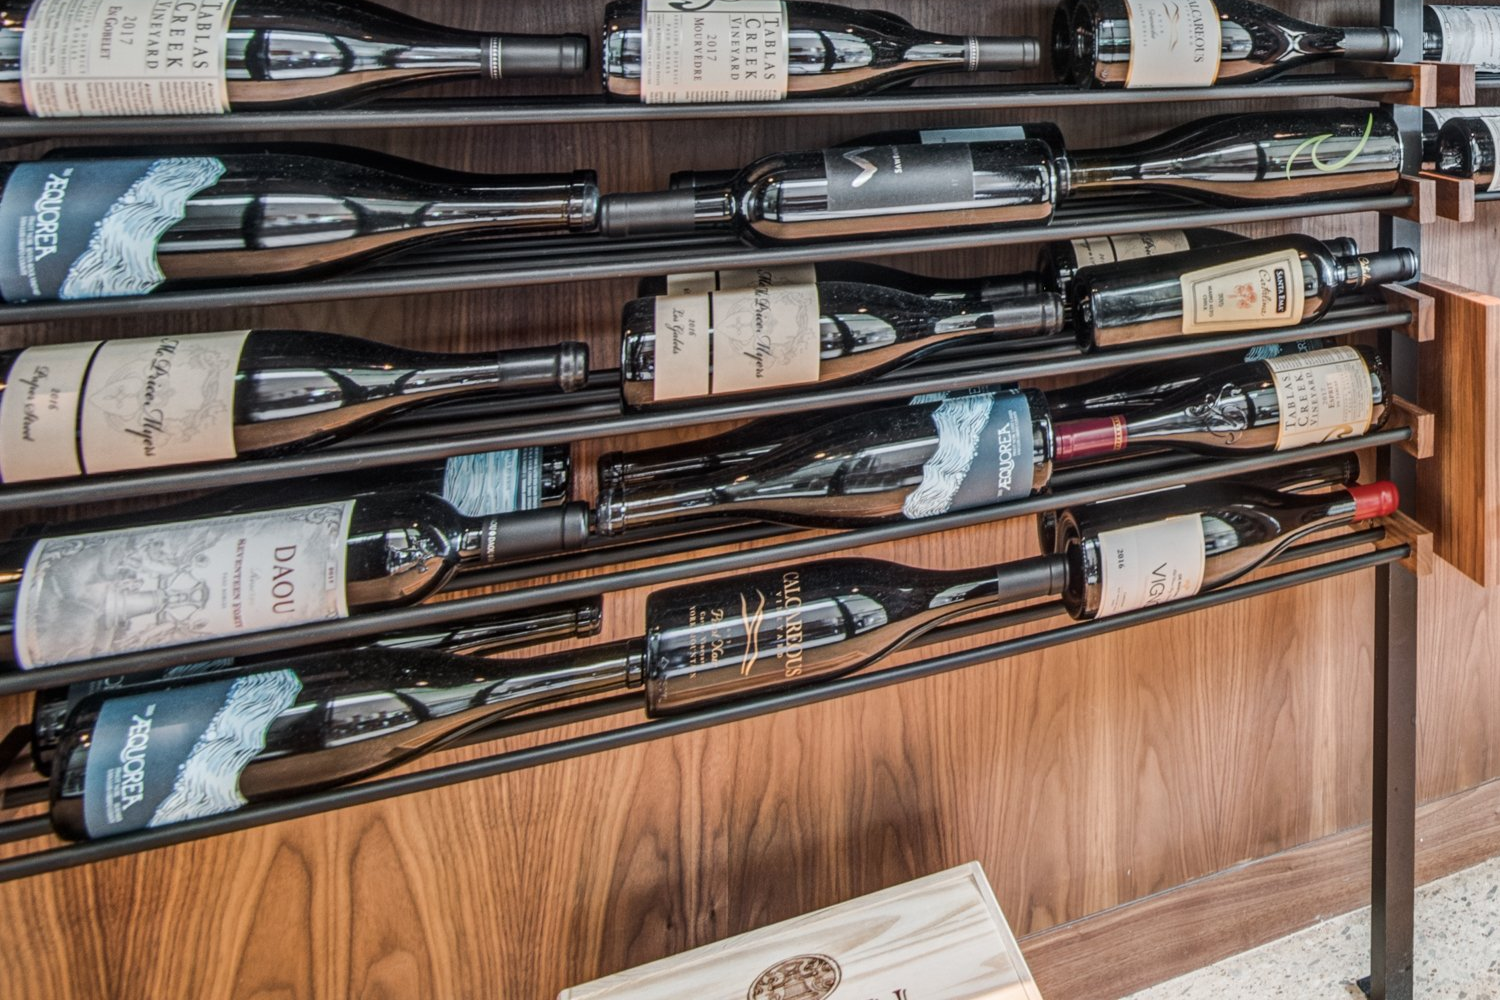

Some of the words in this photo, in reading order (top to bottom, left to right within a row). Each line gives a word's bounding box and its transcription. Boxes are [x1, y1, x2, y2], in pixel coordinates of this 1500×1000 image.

[101, 17, 119, 60] GOBELET
[119, 15, 138, 46] 2017
[146, 0, 173, 70] VINEYARD
[166, 1, 197, 69] CREEK
[192, 0, 224, 70] TABLAS
[706, 34, 717, 62] 2017
[731, 17, 743, 81] VINEYARD
[745, 18, 762, 79] CREEK
[764, 17, 780, 81] TABLAS
[1258, 269, 1271, 317] Catalina
[1274, 269, 1285, 295] SANTA
[688, 318, 697, 337] 2016
[743, 334, 771, 379] Myers
[19, 365, 49, 402] Paper
[48, 386, 61, 411] 2016
[1284, 373, 1296, 431] TABLAS
[1296, 372, 1309, 427] CREEK
[1305, 372, 1318, 426] VINEYARD
[1326, 382, 1335, 409] ESPRIT
[21, 403, 40, 442] Street
[124, 407, 165, 457] Myers
[231, 537, 247, 598] SEVENTEEN
[271, 544, 297, 615] DAOU
[1117, 548, 1126, 570] 2016
[230, 598, 245, 629] FORTY
[783, 571, 803, 678] CALCAREOUS
